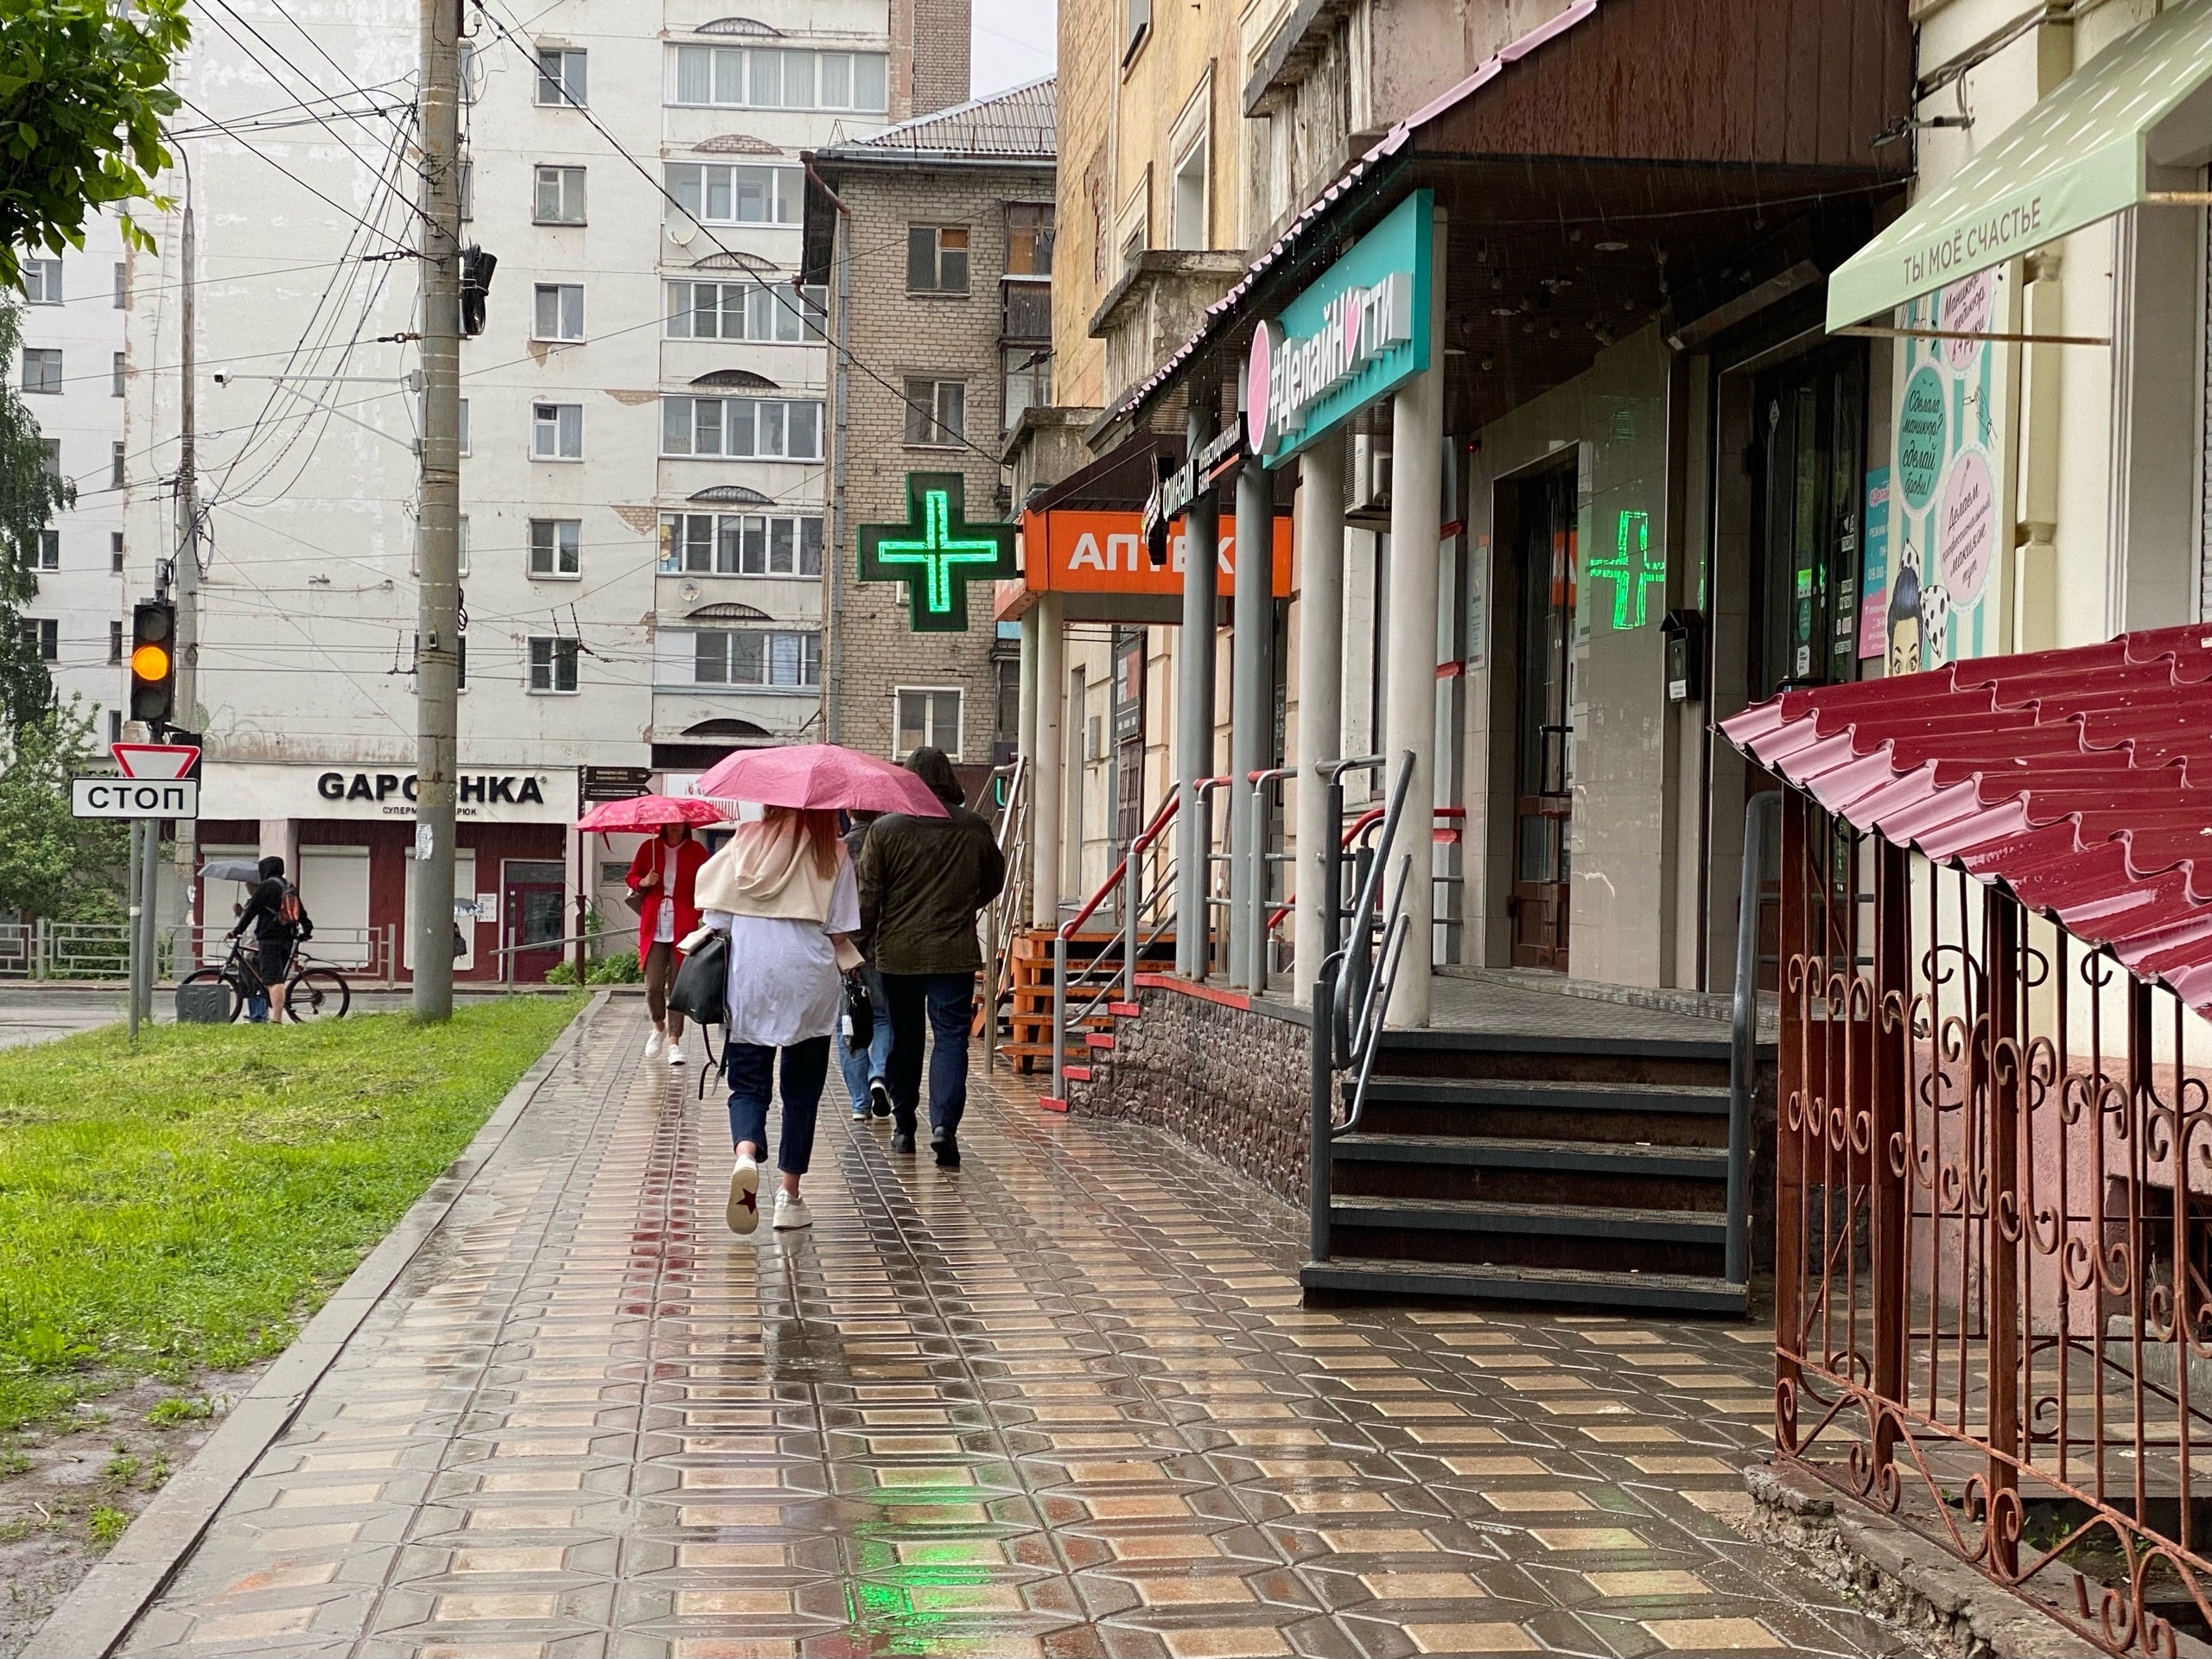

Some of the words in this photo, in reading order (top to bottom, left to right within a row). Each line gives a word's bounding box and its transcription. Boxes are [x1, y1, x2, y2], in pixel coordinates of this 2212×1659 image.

[1904, 251, 1924, 285] ТЫ
[1929, 228, 1962, 275] МОЁ
[1967, 196, 2041, 257] СЧАСТЬЕ
[87, 786, 184, 810] СТОП
